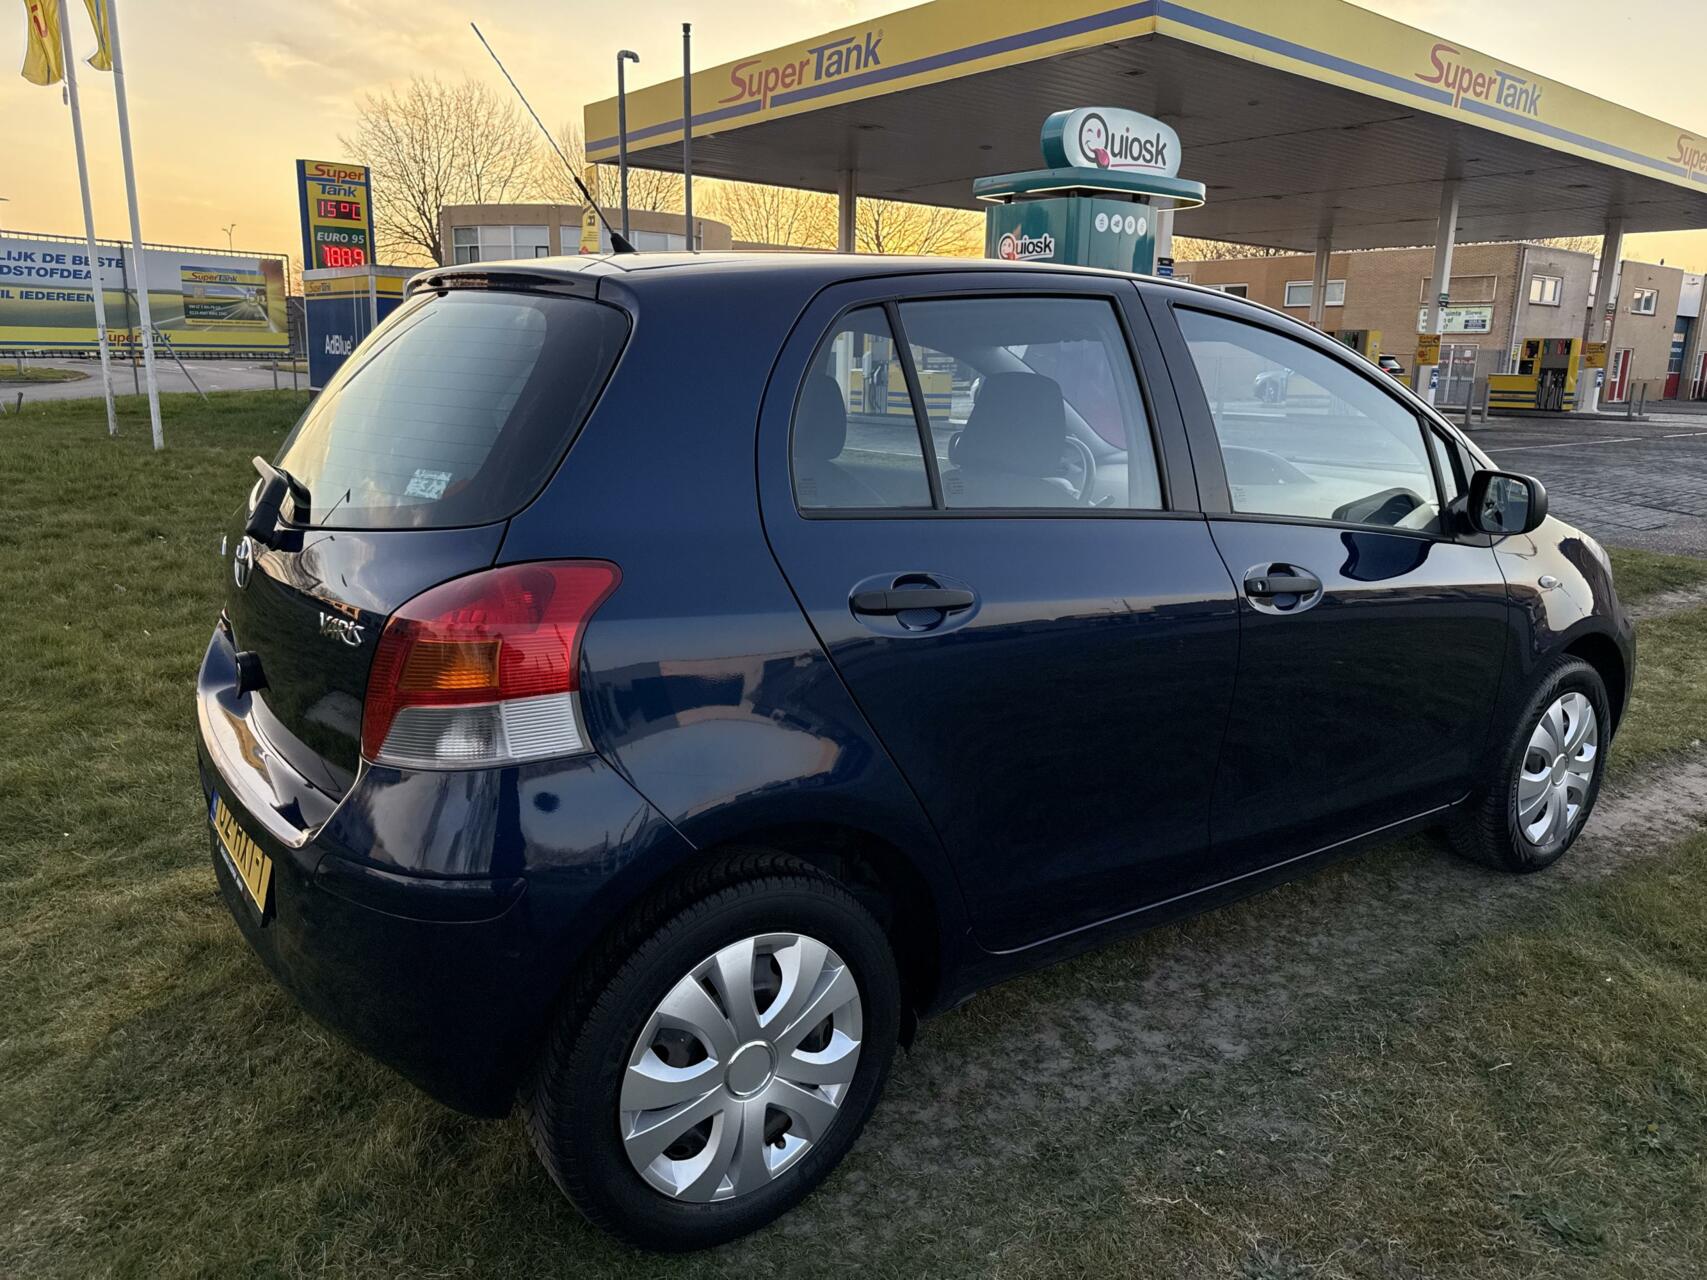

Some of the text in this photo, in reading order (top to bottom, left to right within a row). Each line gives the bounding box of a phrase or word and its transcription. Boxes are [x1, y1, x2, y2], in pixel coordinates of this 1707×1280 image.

[1414, 43, 1542, 116] SuperTank
[1078, 112, 1167, 170] Quiosk
[1667, 133, 1707, 180] Supe
[306, 163, 365, 184] Super
[316, 182, 357, 198] Tank
[316, 231, 365, 245] EURO 95
[999, 233, 1053, 261] Quiosk
[42, 253, 66, 265] DE
